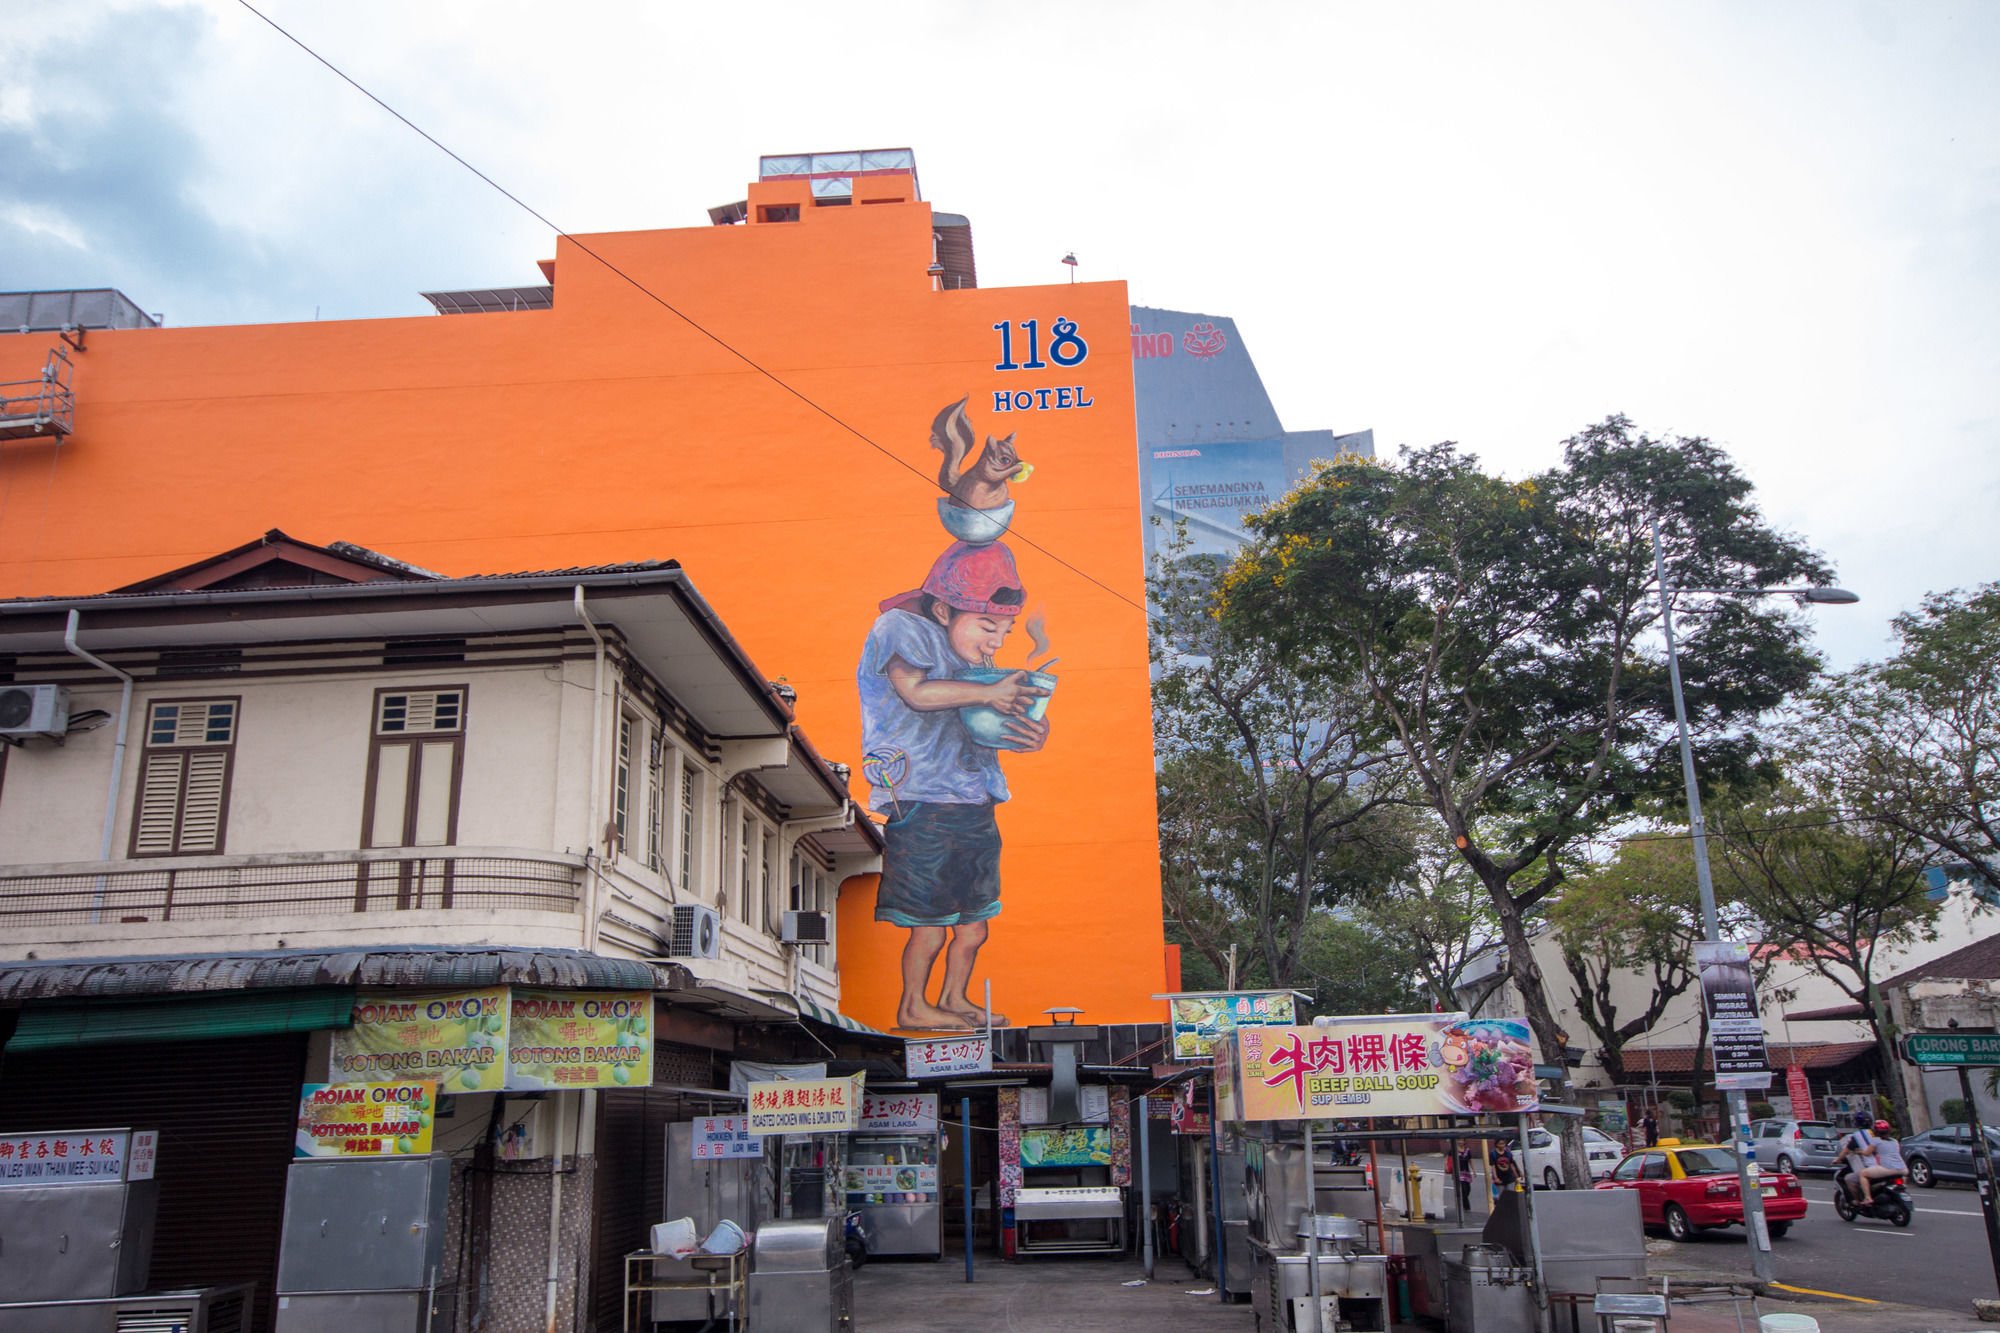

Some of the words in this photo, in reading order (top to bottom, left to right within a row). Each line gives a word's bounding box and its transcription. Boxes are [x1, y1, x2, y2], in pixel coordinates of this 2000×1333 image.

[993, 316, 1088, 370] 118
[992, 386, 1094, 411] HOTEL
[1153, 449, 1200, 458] HONDA
[1174, 481, 1265, 497] SEMEMANGNYA
[1175, 495, 1270, 510] MENGAGUMKAN
[511, 1000, 575, 1020] ROJAK
[1914, 1039, 1968, 1052] LORONG
[1972, 1040, 2000, 1052] BAR
[343, 1051, 423, 1072] SOTONG
[427, 1047, 495, 1067] BAKAR
[511, 1047, 580, 1063] SOTONG
[584, 1046, 640, 1062] BAKAR
[930, 1065, 951, 1073] ASAM
[954, 1063, 979, 1071] LAKSA
[1310, 1077, 1349, 1093] BEEF
[1353, 1076, 1393, 1092] BALL
[1396, 1074, 1439, 1090] SOUP
[313, 1088, 366, 1105] ROJAK
[1311, 1095, 1332, 1106] SUP
[1334, 1093, 1370, 1104] LEMBU
[752, 1113, 775, 1127] ROASTED
[776, 1112, 797, 1126] CHICKEN
[799, 1112, 811, 1125] WING
[817, 1111, 831, 1124] DRUM
[832, 1110, 846, 1124] STICK
[892, 1120, 917, 1128] LAKSA
[311, 1122, 367, 1137] SOTONG
[370, 1121, 420, 1136] BAKAR
[707, 1132, 733, 1141] HOKKIEN
[737, 1131, 748, 1140] MEE
[733, 1143, 744, 1152] LOR
[747, 1142, 759, 1152] MEE
[7, 1163, 23, 1178] LEG
[25, 1162, 42, 1176] WAN
[45, 1161, 66, 1176] THAN
[103, 1160, 120, 1174] KAO
